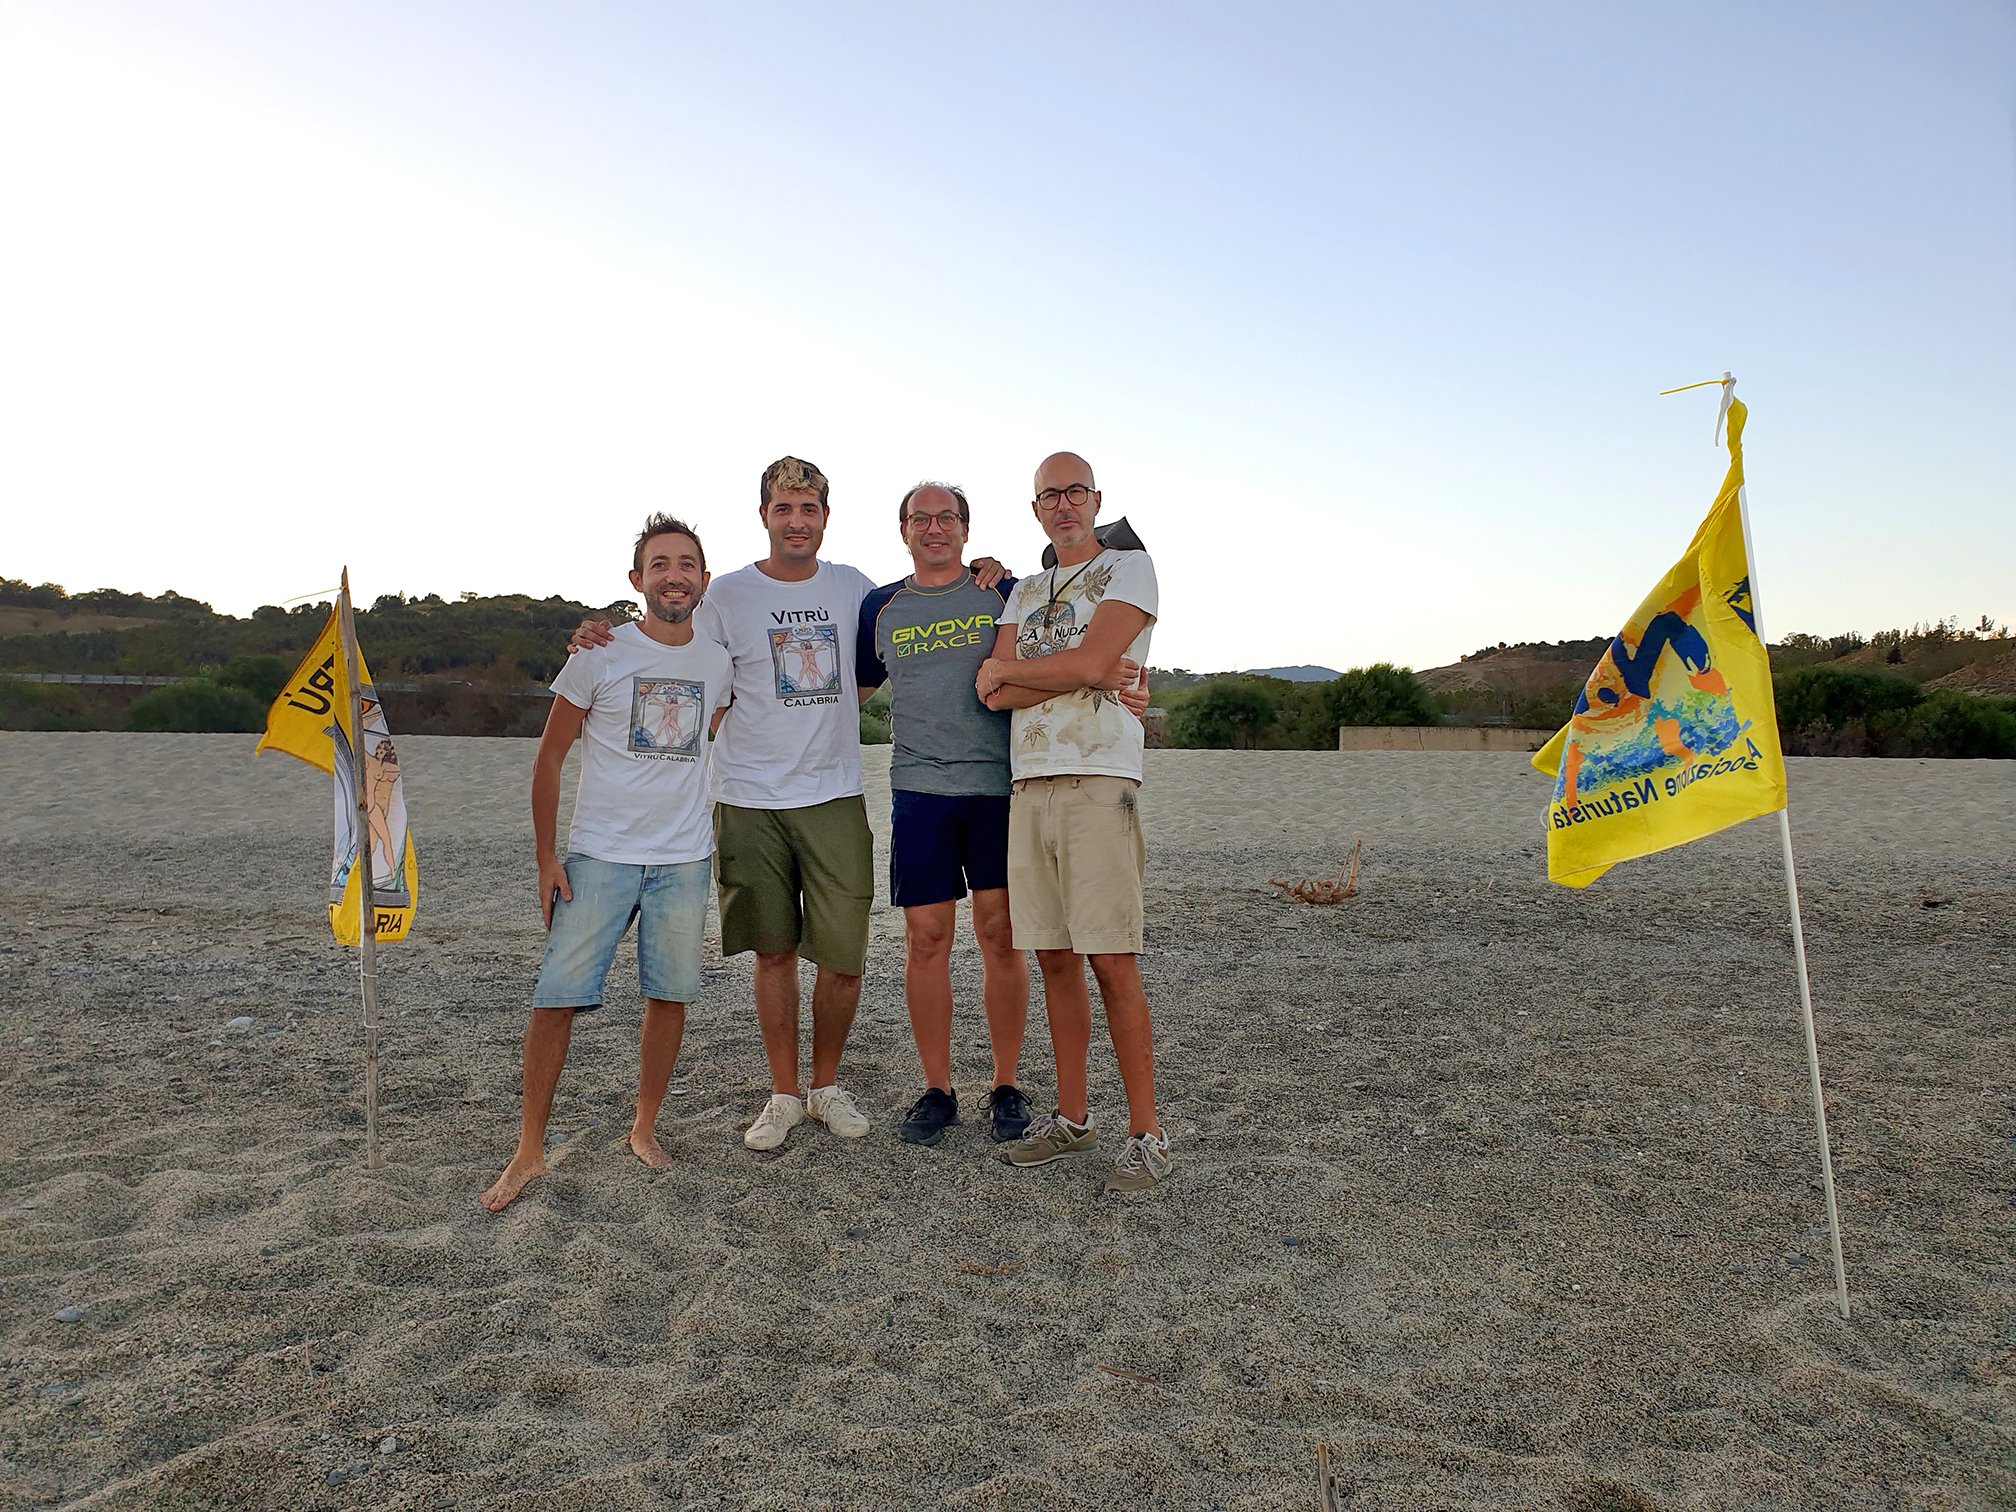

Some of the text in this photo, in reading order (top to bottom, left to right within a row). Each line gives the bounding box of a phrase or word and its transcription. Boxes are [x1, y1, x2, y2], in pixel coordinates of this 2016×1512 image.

[770, 606, 830, 625] VITRÙ
[892, 614, 994, 644] GIVOVA
[1054, 623, 1089, 640] NUDA
[913, 631, 982, 654] RACE
[783, 695, 839, 708] CALABRIA
[659, 754, 696, 763] CALABRIA
